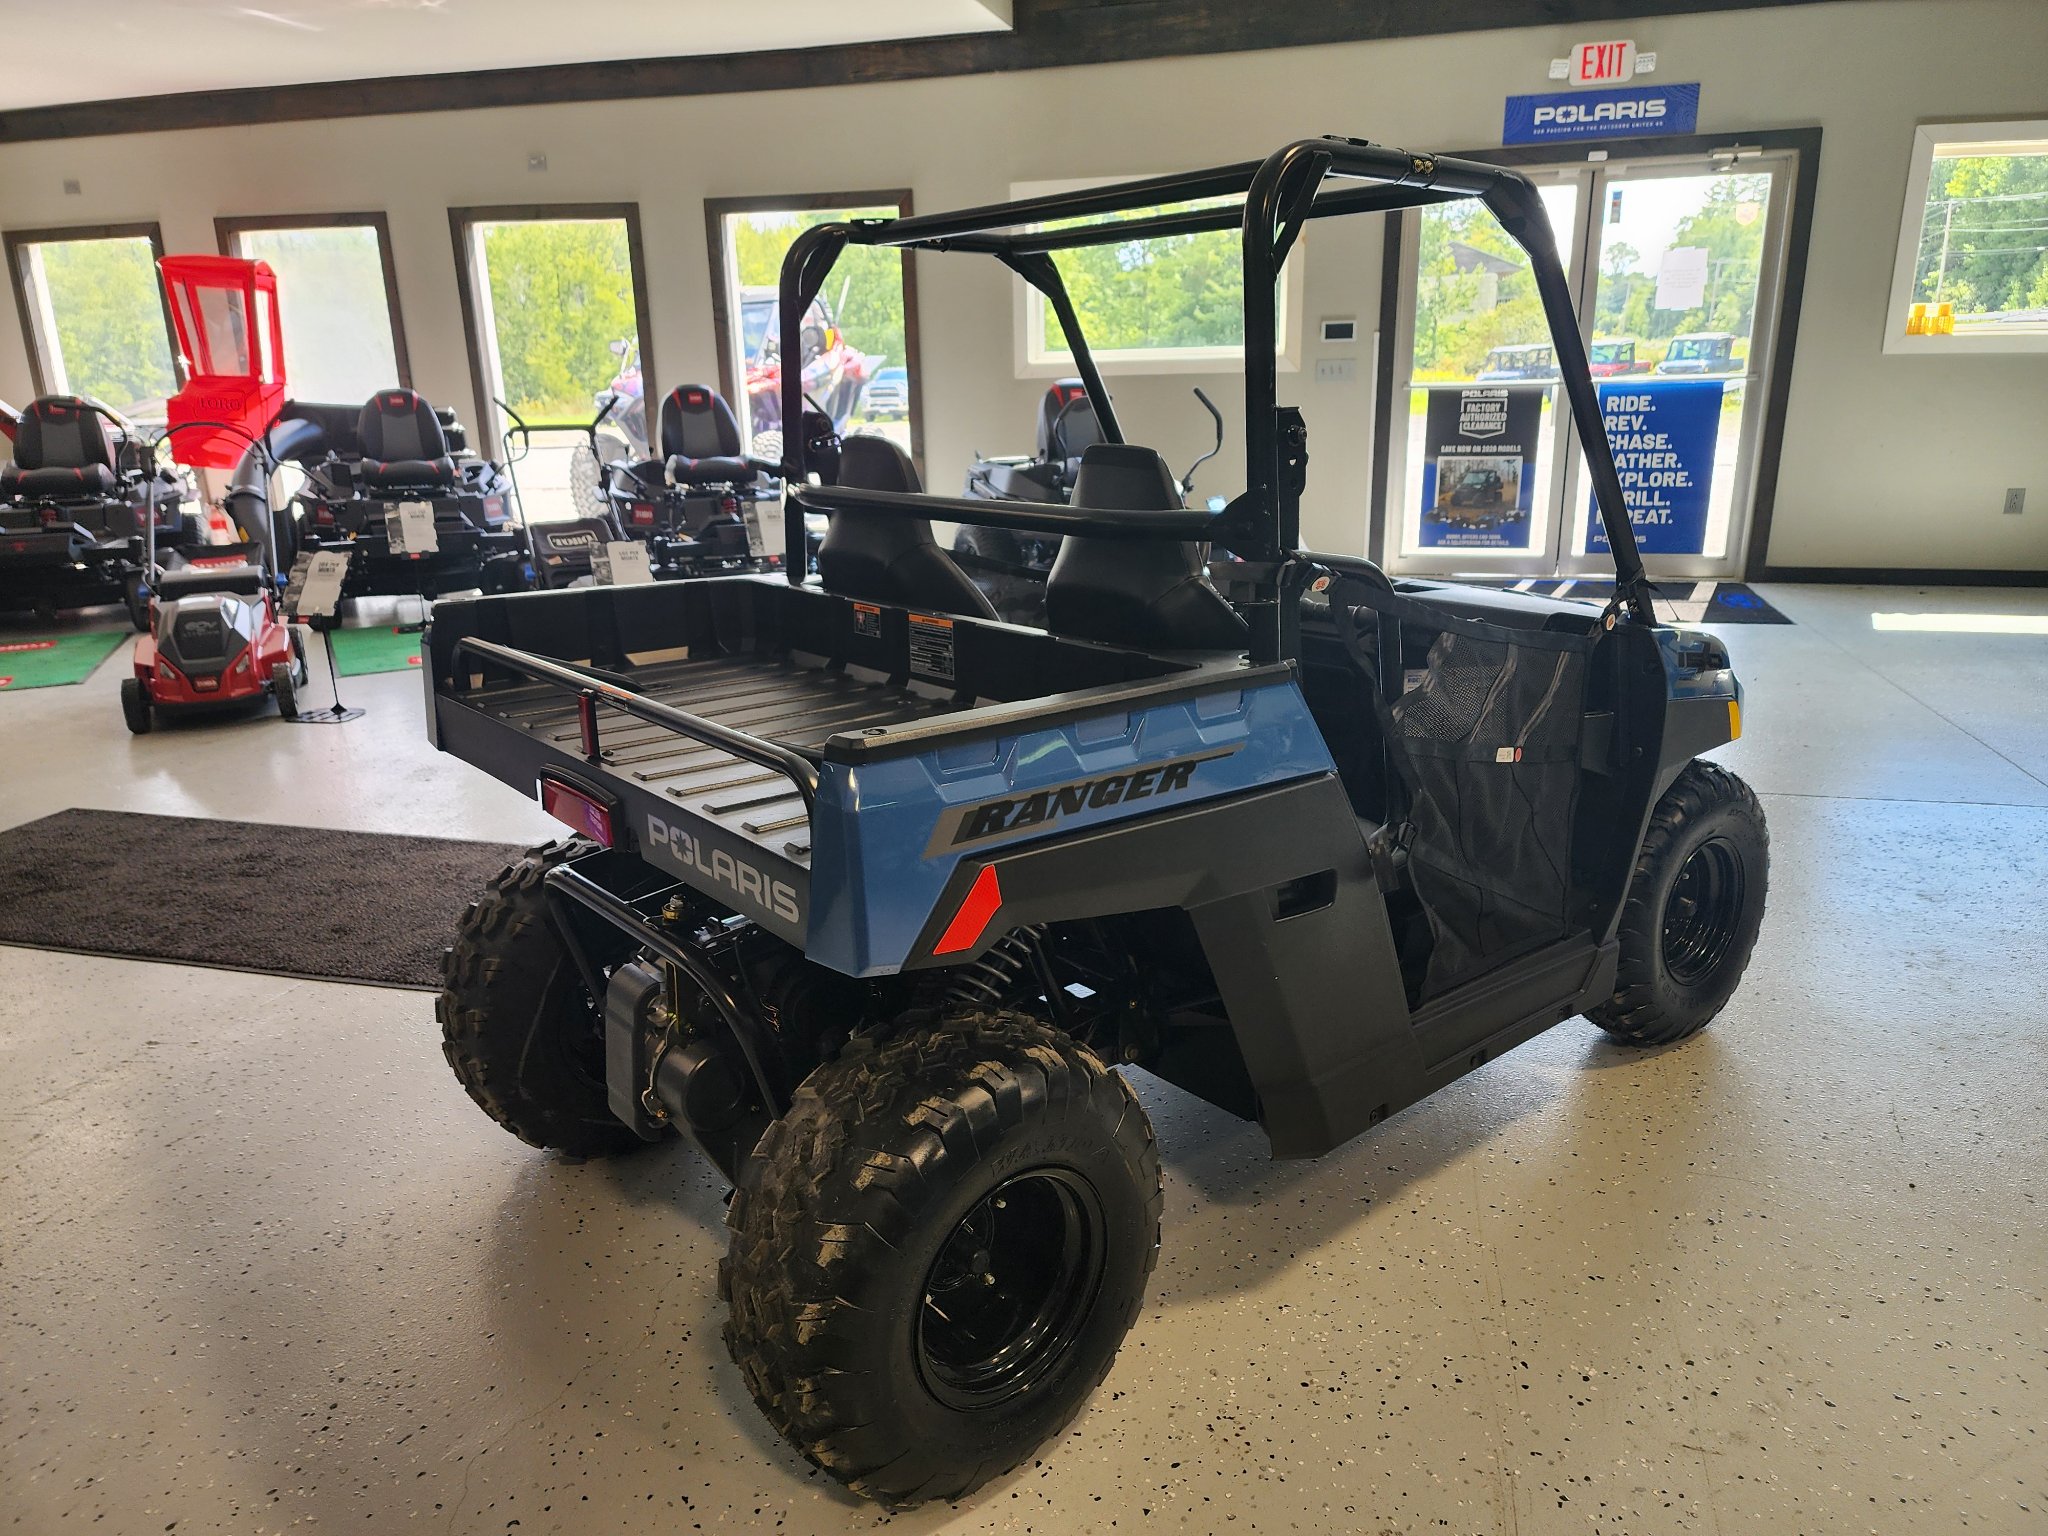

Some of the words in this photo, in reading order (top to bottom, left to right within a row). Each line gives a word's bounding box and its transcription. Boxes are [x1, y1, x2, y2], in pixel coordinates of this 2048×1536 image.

[1581, 42, 1627, 80] EXIT
[1533, 98, 1667, 126] POLARIS
[1461, 389, 1508, 398] POLARIS
[1466, 402, 1501, 412] FACTORY
[1606, 395, 1656, 412] RIDE.
[1460, 412, 1507, 422] AUTHORIZED
[1462, 421, 1502, 430] CLEARANCE
[1604, 415, 1647, 431] REV.
[1614, 452, 1682, 469] ATHER.
[1623, 490, 1671, 507] RILL.
[967, 760, 1197, 839] RANGER
[647, 813, 800, 924] POLARIS
